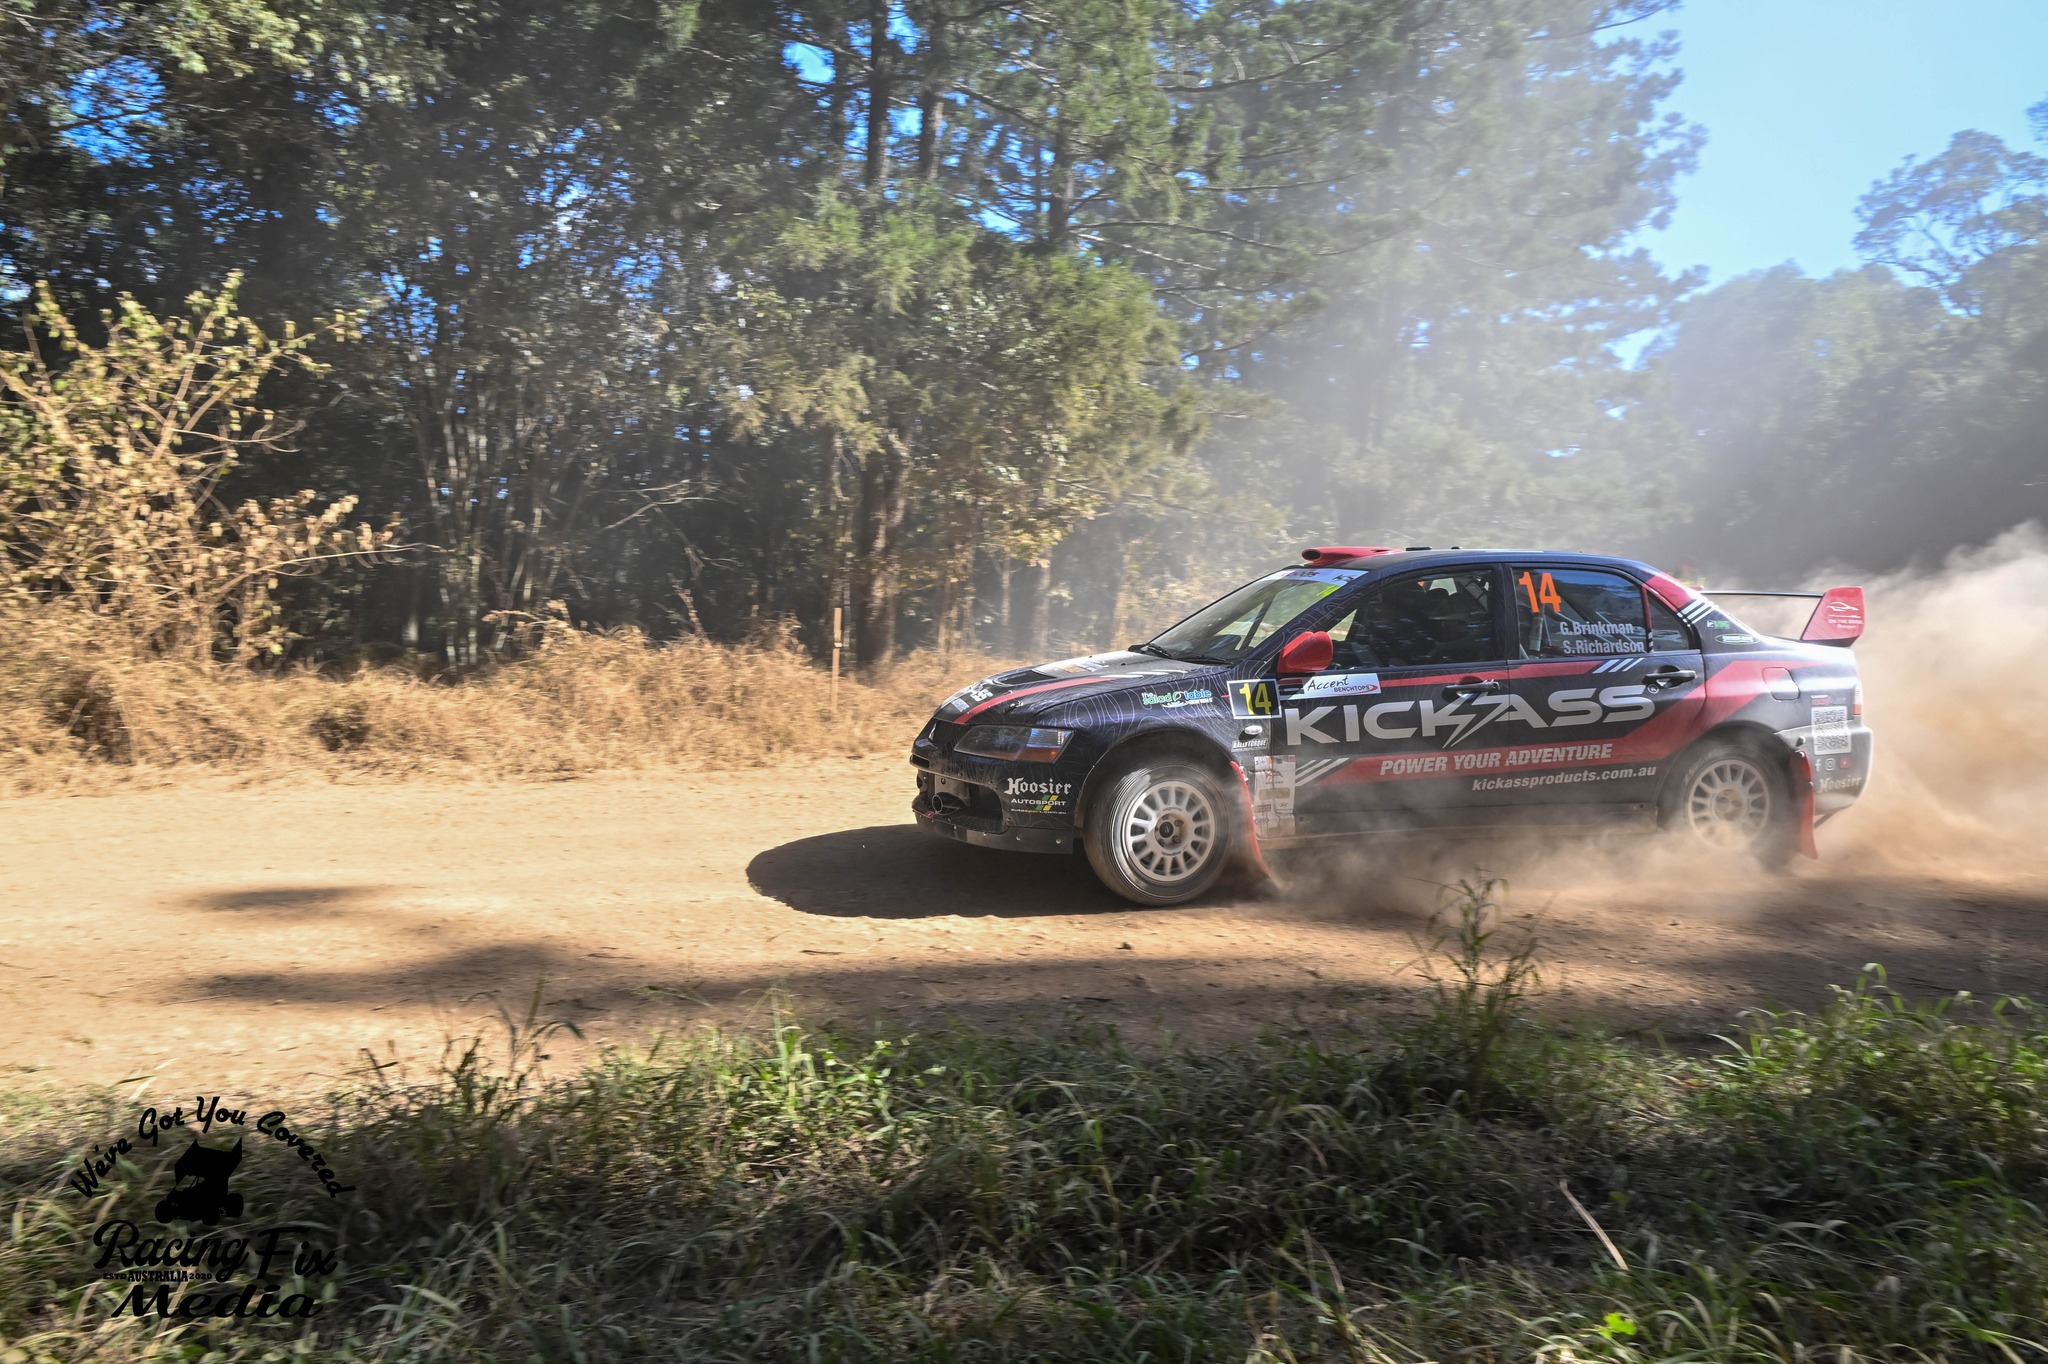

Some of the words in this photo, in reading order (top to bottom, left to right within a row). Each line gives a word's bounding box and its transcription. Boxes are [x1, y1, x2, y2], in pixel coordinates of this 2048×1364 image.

[1518, 571, 1562, 613] 14
[1307, 675, 1349, 691] Accent
[1333, 685, 1370, 693] BENCHTOPS
[1184, 689, 1212, 700] table
[1239, 683, 1272, 715] 14
[1285, 684, 1656, 748] KICKASS
[1380, 756, 1447, 776] POWER
[1451, 752, 1502, 771] YOUR
[1503, 743, 1613, 768] ADVENTURE
[1004, 777, 1072, 795] Hoosier
[1472, 765, 1657, 791] kickassproducts.com.au
[1011, 798, 1067, 806] AUTOSPORT
